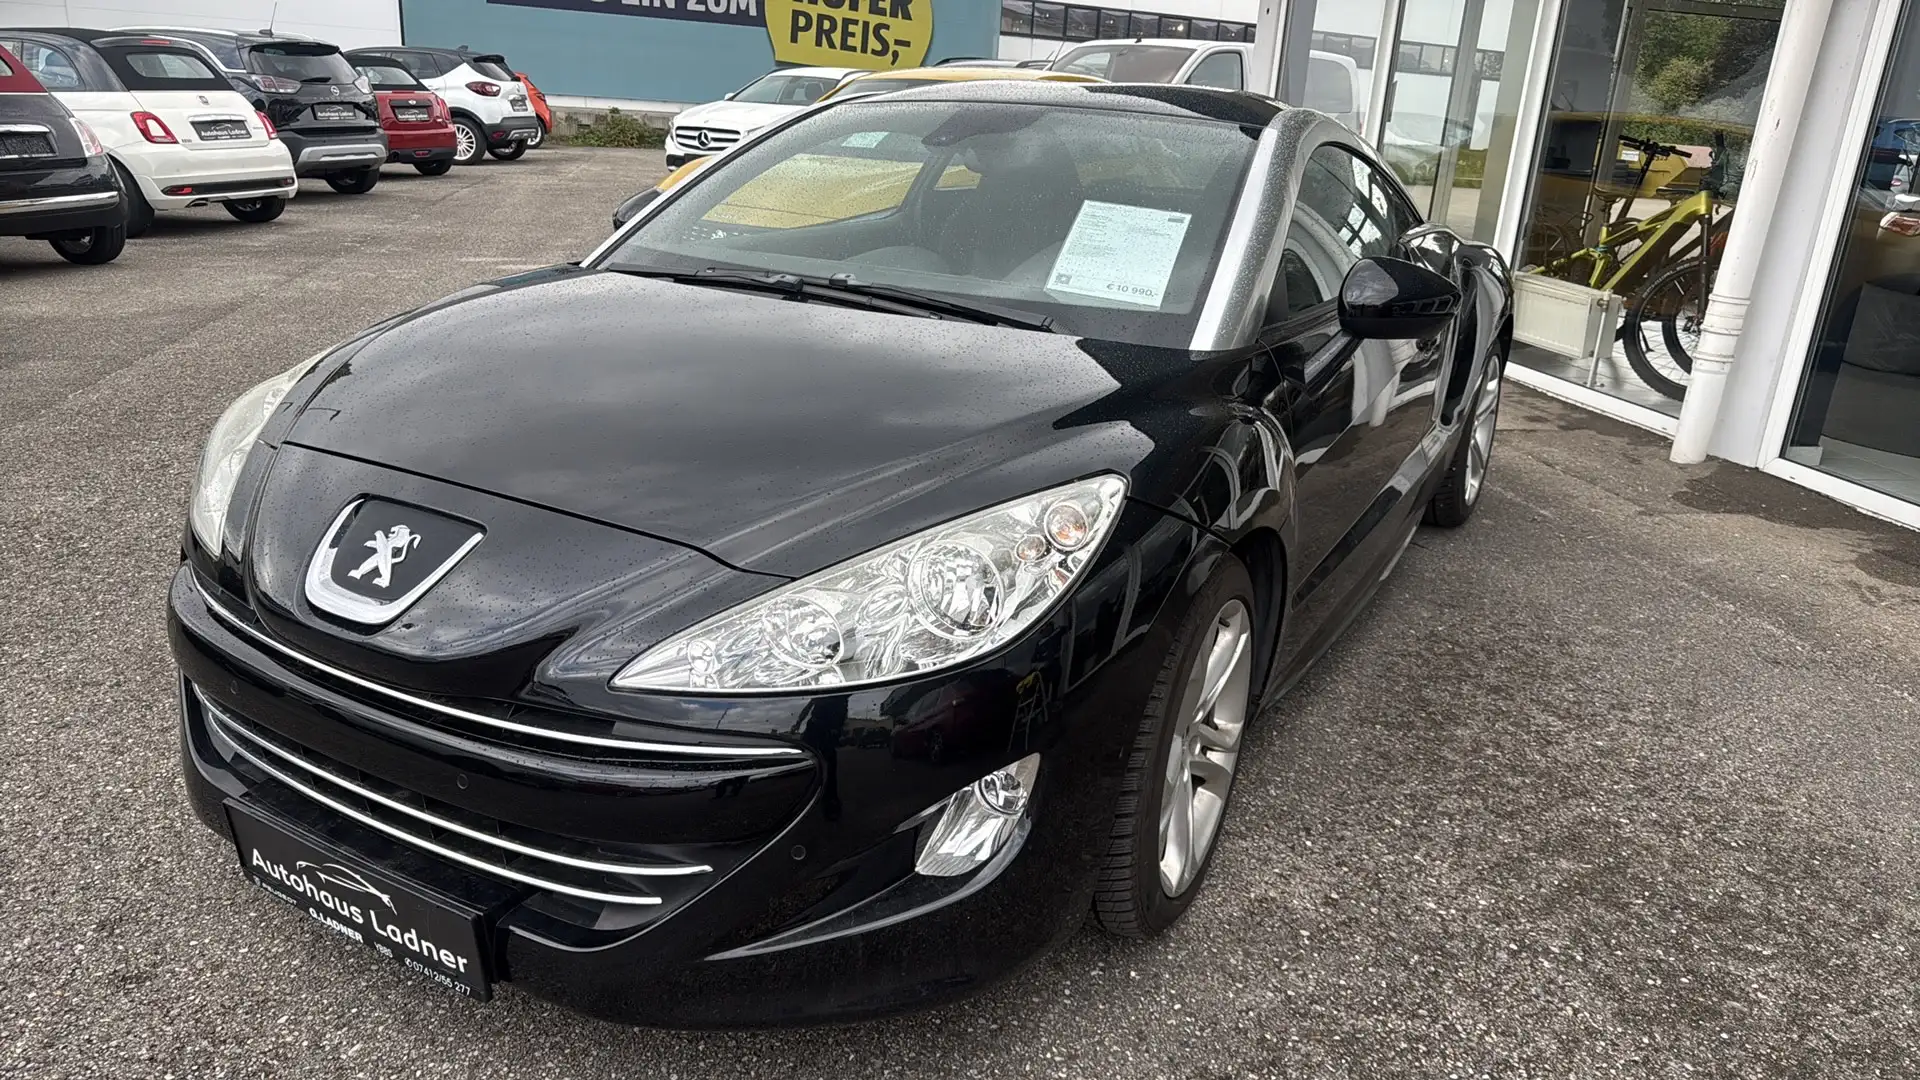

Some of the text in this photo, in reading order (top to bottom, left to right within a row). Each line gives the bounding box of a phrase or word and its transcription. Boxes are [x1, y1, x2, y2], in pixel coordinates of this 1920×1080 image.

[789, 9, 912, 66] PREIS,-
[252, 848, 468, 973] Autohaus Ladner
